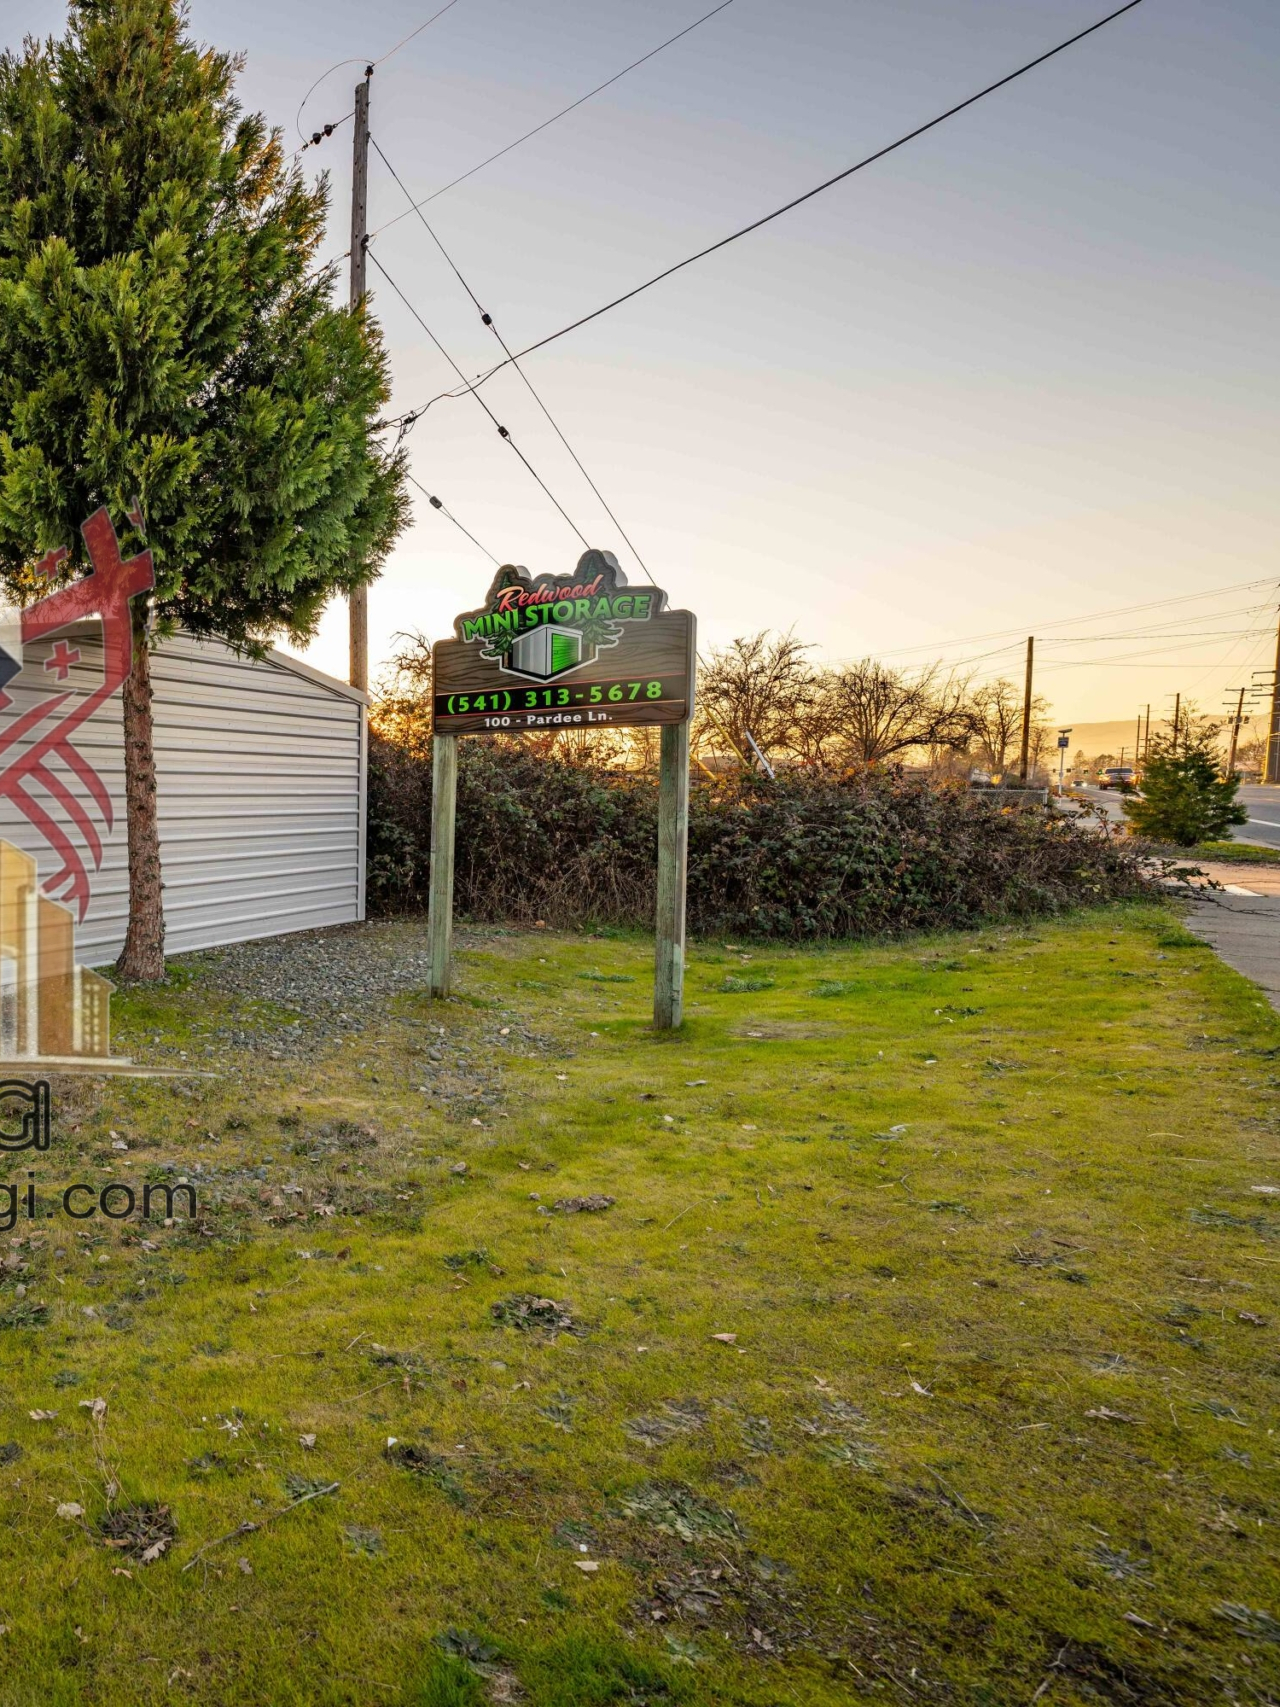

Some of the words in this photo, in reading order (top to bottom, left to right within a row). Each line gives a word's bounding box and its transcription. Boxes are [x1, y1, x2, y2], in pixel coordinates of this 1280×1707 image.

[496, 574, 604, 612] Redwood
[463, 611, 518, 641] MINI
[525, 595, 651, 627] STORAGE
[448, 692, 511, 715] (541)
[525, 682, 662, 708] 313-5678
[484, 716, 511, 728] 100
[526, 713, 582, 726] Pardee
[588, 710, 613, 723] Ln.
